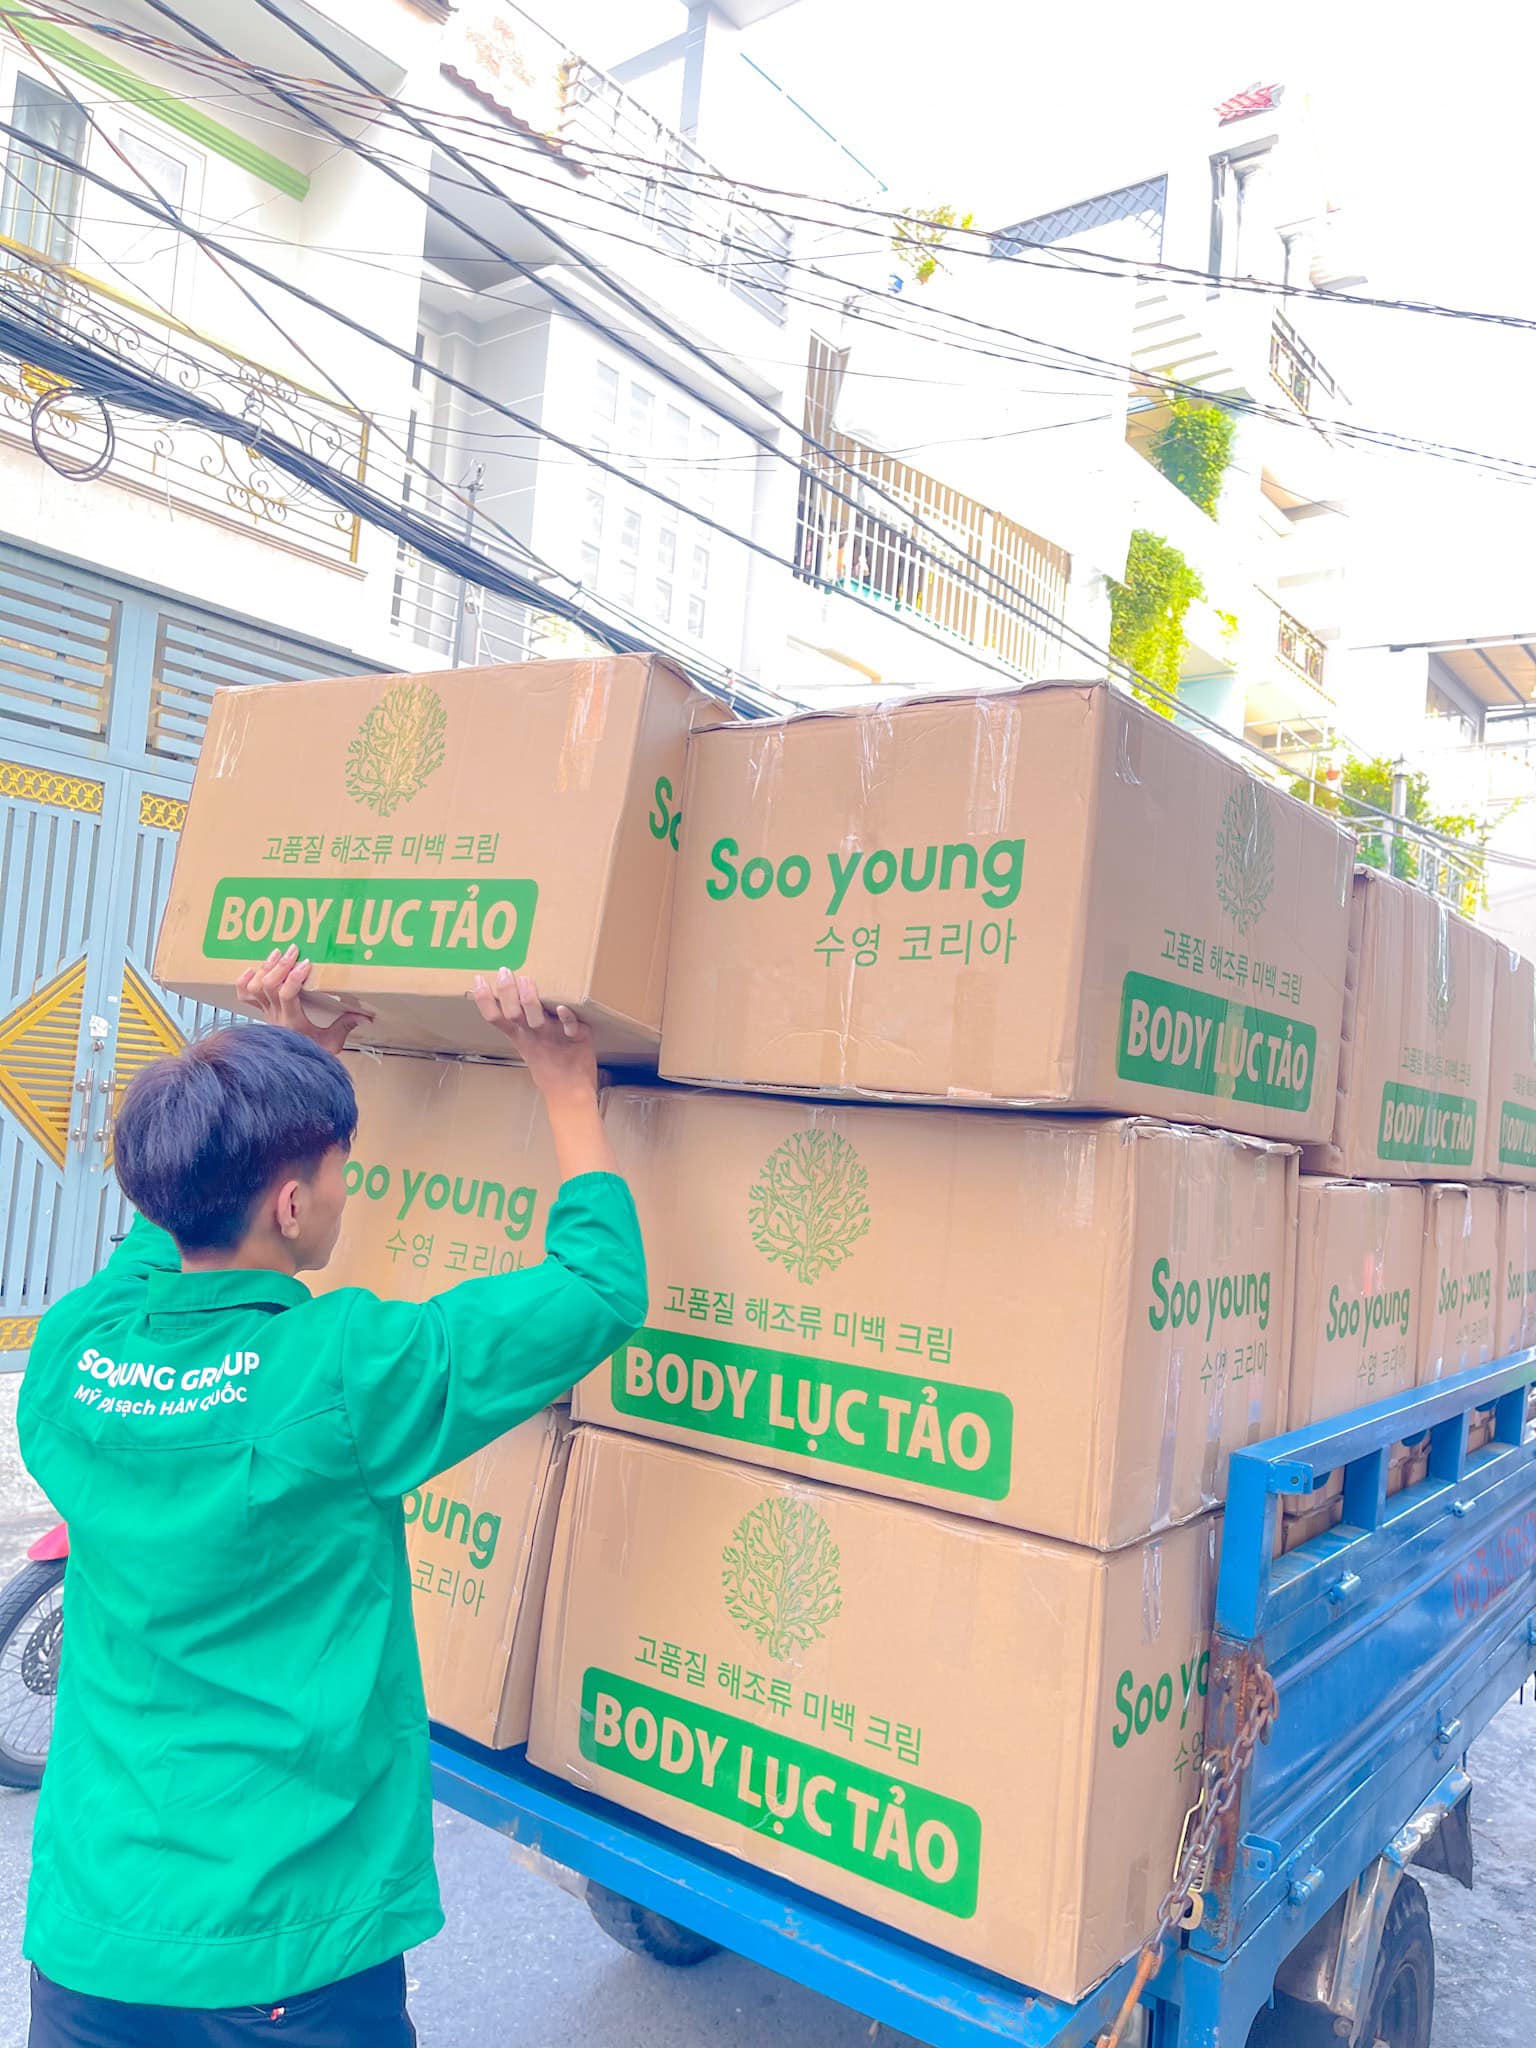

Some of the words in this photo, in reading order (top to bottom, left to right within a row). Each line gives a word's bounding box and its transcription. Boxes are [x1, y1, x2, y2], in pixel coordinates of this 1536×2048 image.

[262, 834, 323, 864] 고품질
[330, 834, 394, 864] 해조류
[401, 833, 446, 863] 미백
[451, 832, 500, 864] 크림
[706, 837, 811, 901] Soo
[825, 838, 1026, 916] young
[216, 896, 333, 944] BODY
[335, 899, 421, 960] LỤC
[429, 884, 518, 950] TẢO
[813, 924, 880, 967] 수영
[898, 918, 1017, 965] 코리아
[1161, 928, 1206, 974] 고품질
[1210, 945, 1249, 989] 해조류
[1252, 961, 1277, 998] 미백
[1279, 971, 1302, 1005] 크림
[1127, 999, 1213, 1070] BODY
[1266, 1024, 1309, 1091] TẢO
[1384, 1100, 1424, 1144] BODY
[343, 1161, 390, 1200] oo
[397, 1168, 537, 1241] young
[385, 1229, 434, 1268] 수영
[444, 1241, 524, 1275] 코리아
[1439, 1267, 1458, 1314] Soo
[663, 1285, 734, 1325] 고품질
[744, 1297, 822, 1340] 해조류
[833, 1311, 885, 1352] 미백
[896, 1323, 953, 1364] 크림
[1149, 1257, 1201, 1331] Soo
[1206, 1272, 1270, 1342] young
[1326, 1284, 1360, 1342] Soo
[1362, 1288, 1410, 1348] young
[181, 1351, 260, 1391] GRUP
[1232, 1340, 1268, 1381] 코리아
[625, 1346, 757, 1419] BODY
[769, 1373, 868, 1451] LỤC
[879, 1386, 991, 1471] TẢO
[402, 1488, 502, 1569] oung
[411, 1560, 486, 1616] 코리아
[634, 1635, 707, 1688] 고품질
[717, 1662, 793, 1717] 해조류
[803, 1692, 855, 1742] 미백
[864, 1714, 922, 1766] 크림
[1113, 1670, 1172, 1748] Soo
[594, 1692, 728, 1788] BODY
[737, 1745, 837, 1834] LỤC
[846, 1785, 959, 1883] TẢO
